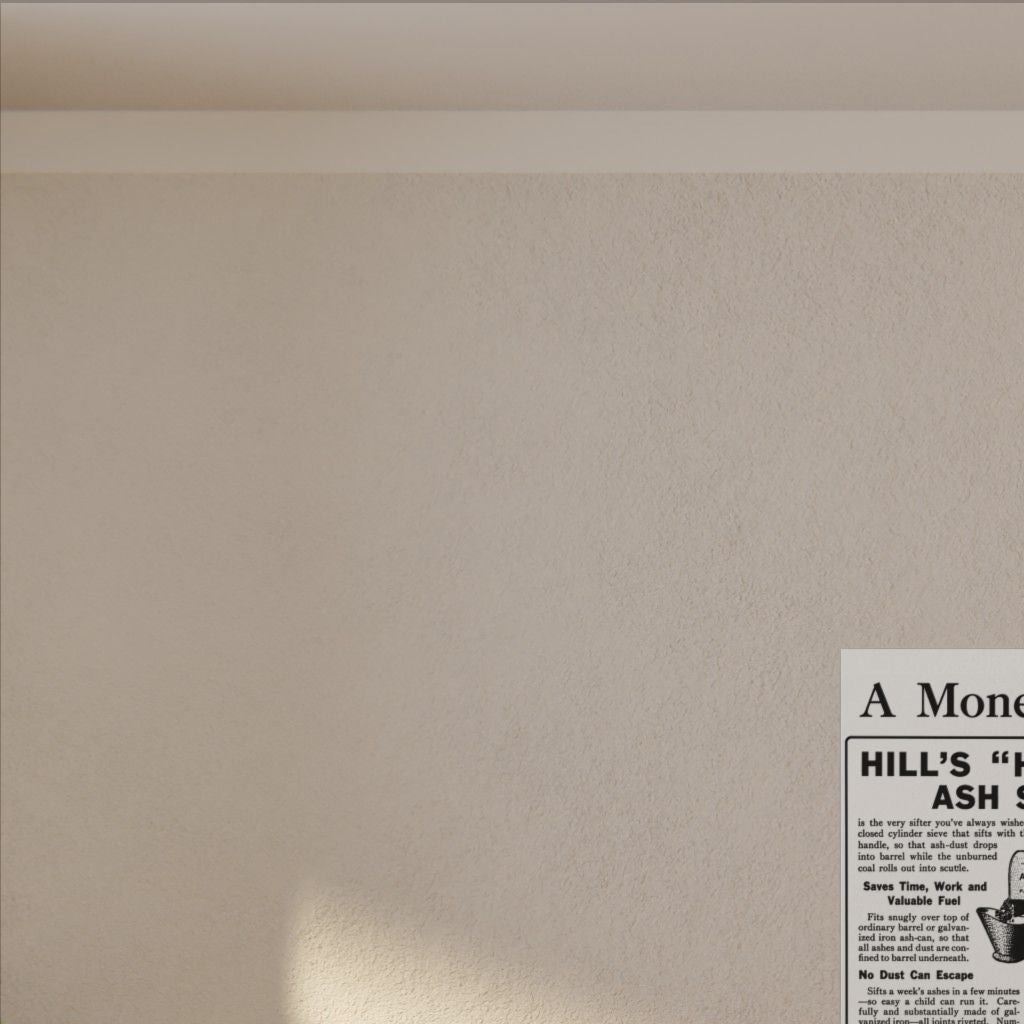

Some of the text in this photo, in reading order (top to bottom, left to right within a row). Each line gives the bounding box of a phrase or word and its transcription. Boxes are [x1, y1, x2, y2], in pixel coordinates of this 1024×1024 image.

[860, 682, 896, 717] A
[862, 751, 970, 777] HILL’S
[932, 784, 998, 809] ASH
[858, 818, 865, 826] is
[870, 818, 883, 826] the
[910, 818, 931, 826] sifter
[967, 818, 995, 828] always
[858, 829, 884, 837] closed
[888, 829, 922, 839] cylinder
[927, 829, 947, 837] sieve
[952, 829, 969, 837] that
[974, 829, 992, 837] sifts
[997, 829, 1017, 837] with
[858, 841, 889, 850] handle,
[908, 841, 925, 849] that
[931, 840, 968, 848] ash-dust
[973, 840, 997, 850] drops
[858, 852, 997, 860] into barrel while the unburned
[858, 864, 875, 872] coal
[879, 864, 897, 872] rolls
[919, 864, 936, 872] into
[940, 864, 968, 872] scuttle.
[863, 881, 987, 893] Saves Time, Work and
[888, 896, 960, 905] Valuable Fuel
[868, 913, 884, 921] Fits
[888, 913, 917, 923] snugly
[943, 915, 957, 923] top
[961, 913, 969, 921] of
[858, 923, 895, 934] ordinary
[898, 922, 923, 931] barrel
[938, 922, 969, 933] galvan-
[859, 933, 875, 941] ized
[900, 933, 934, 942] ash-can,
[859, 970, 973, 981] No Dust Can Escape
[867, 987, 887, 995] Sifts
[927, 987, 950, 995] ashes
[952, 987, 960, 995] in
[970, 987, 985, 995] few
[988, 987, 1020, 995] minutes
[881, 1000, 900, 1008] easy
[915, 997, 935, 1006] child
[980, 997, 988, 1006] it.
[997, 997, 1020, 1006] Care-
[859, 1007, 1020, 1017] fully and substantially made of gal-
